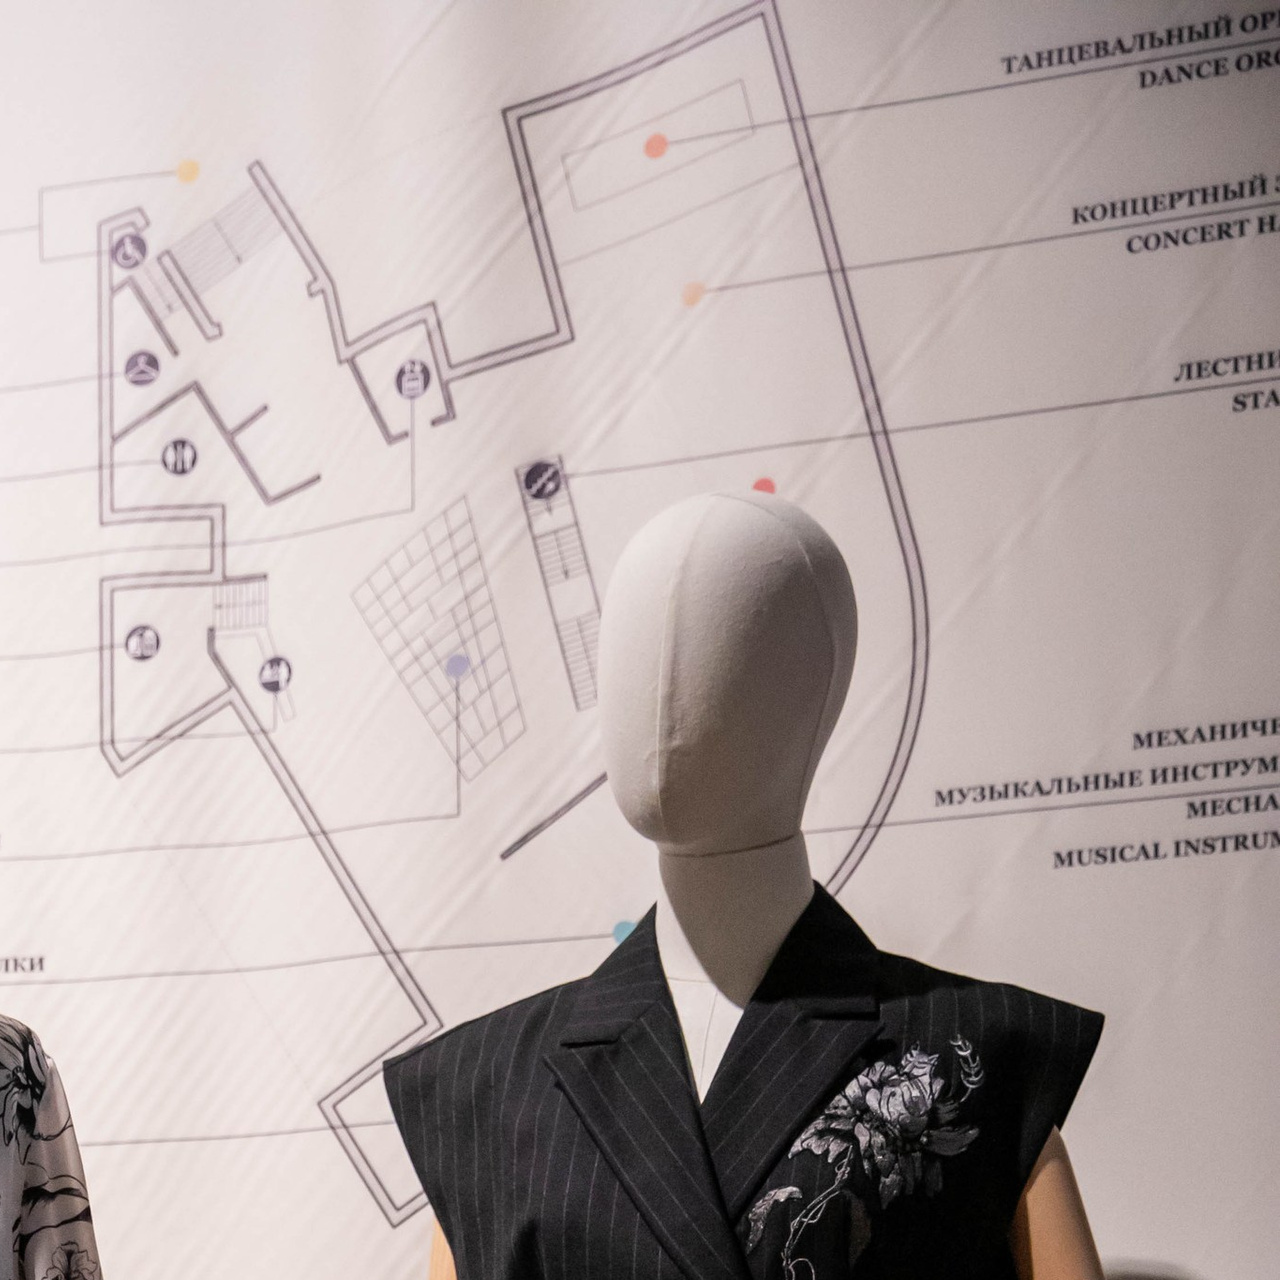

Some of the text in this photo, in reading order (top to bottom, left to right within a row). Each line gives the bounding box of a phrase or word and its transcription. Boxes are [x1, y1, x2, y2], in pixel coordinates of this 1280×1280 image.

[1002, 10, 1280, 75] ТАНЦЕВАЛЬНЫЙ ОР
[1139, 57, 1229, 89] DANCE
[1072, 173, 1267, 225] КОНЦЕРТНЫЙ
[1126, 214, 1280, 254] CONCERT H
[934, 769, 1143, 808] МУЗЫКАЛЬНЫЕ
[1052, 842, 1167, 871] MUSICAL
